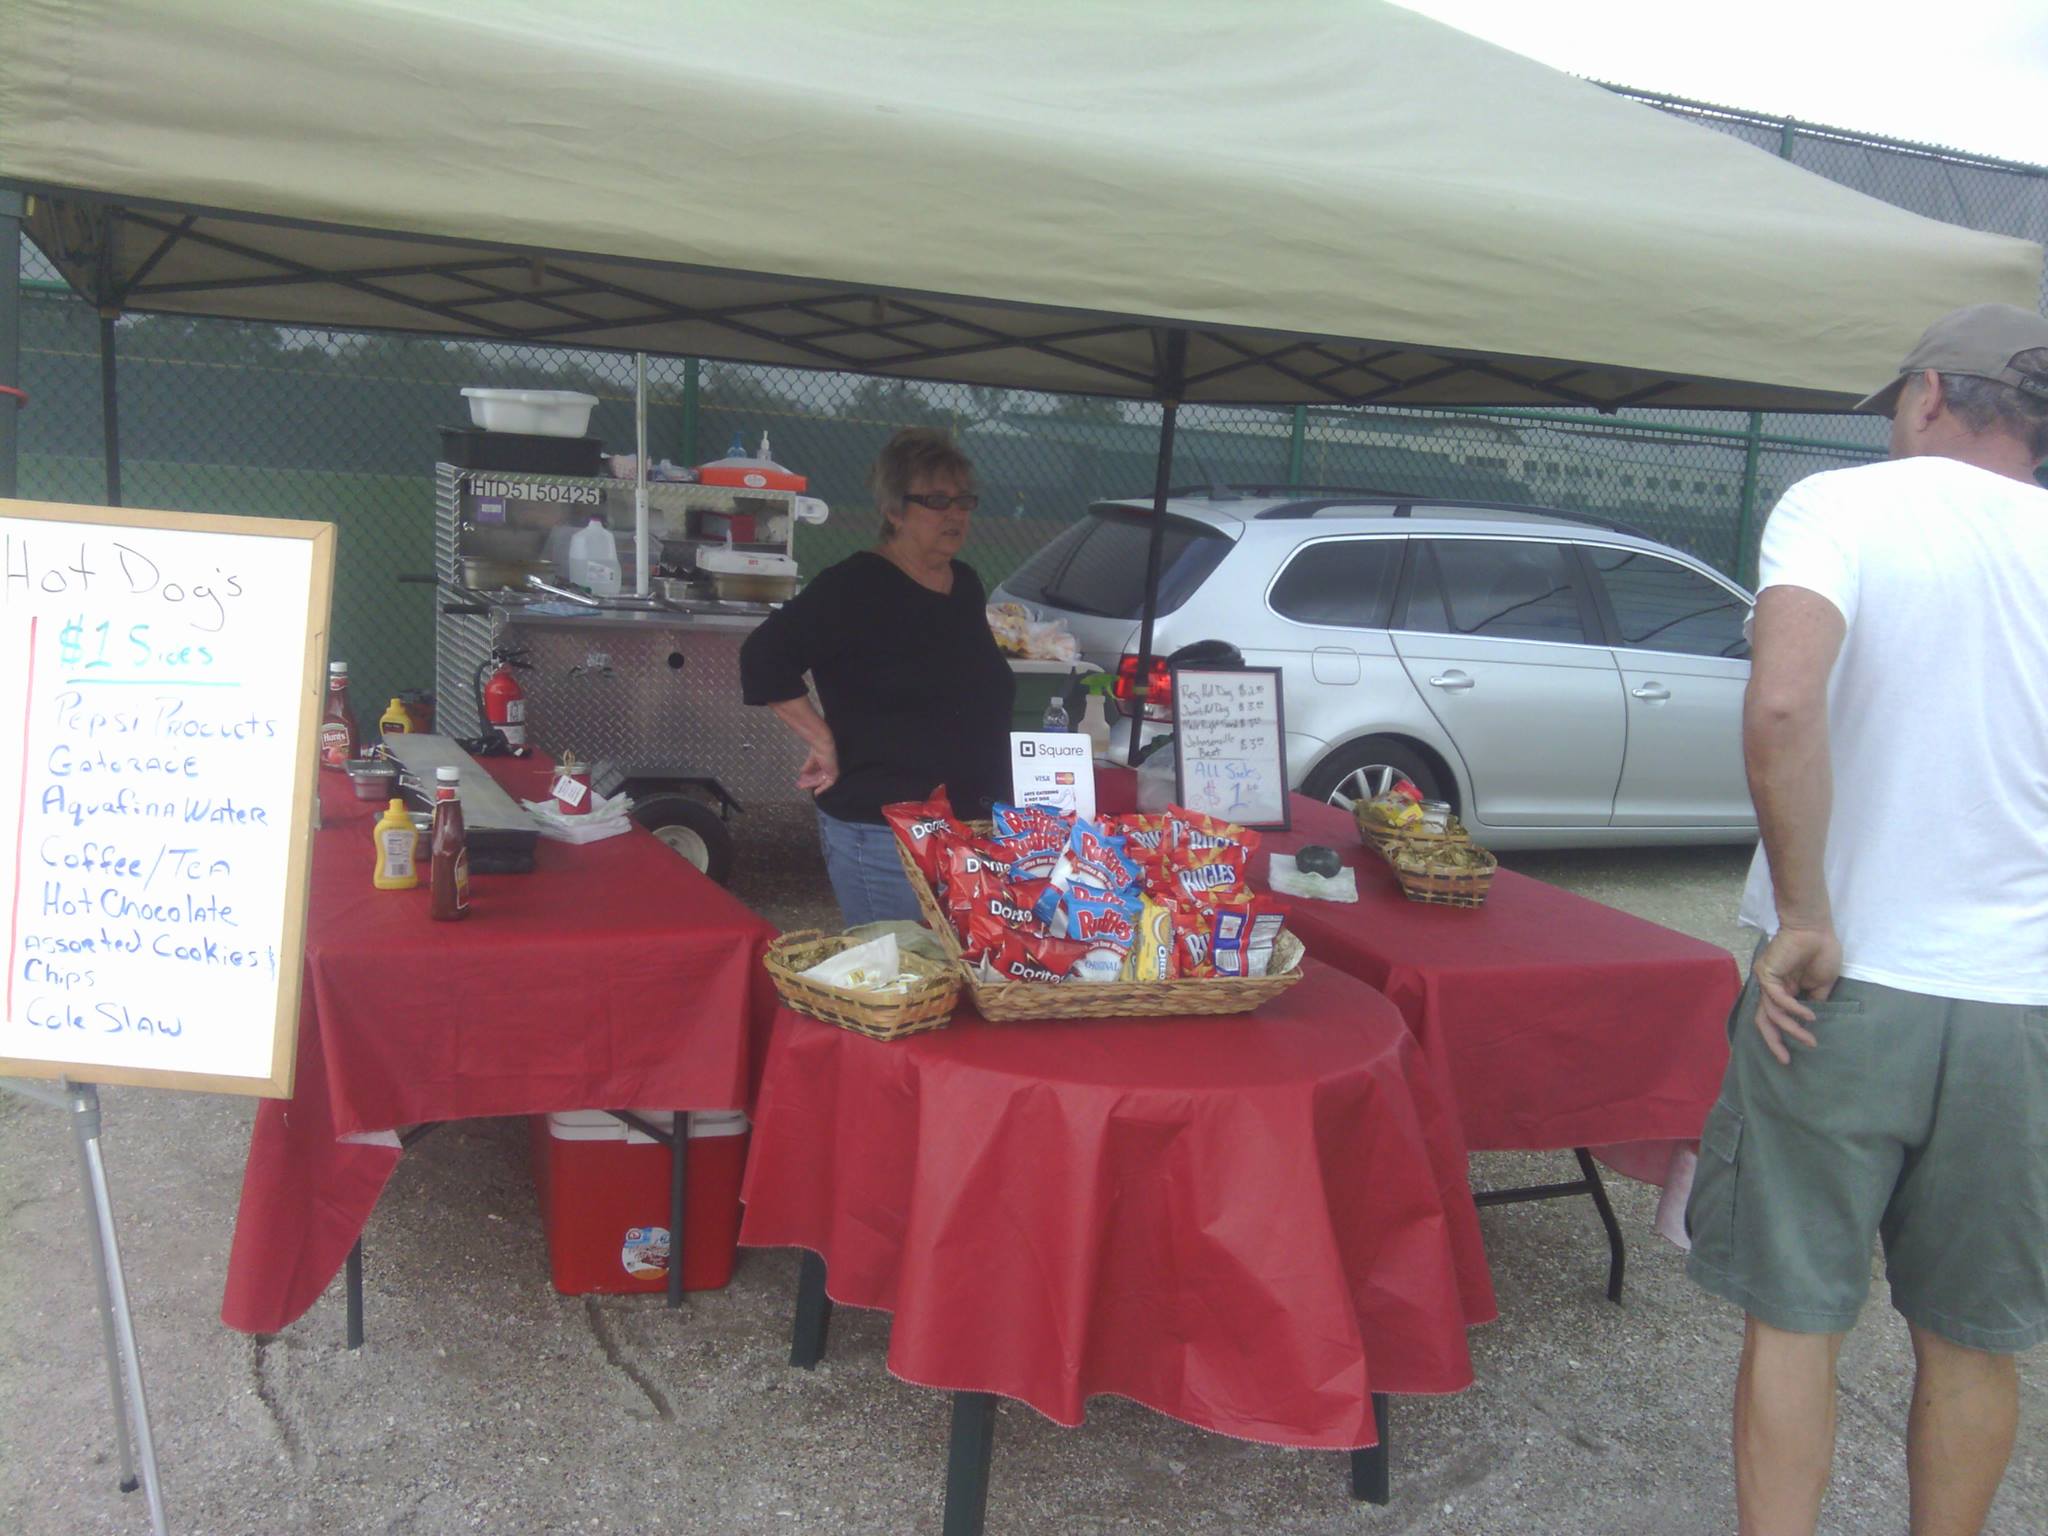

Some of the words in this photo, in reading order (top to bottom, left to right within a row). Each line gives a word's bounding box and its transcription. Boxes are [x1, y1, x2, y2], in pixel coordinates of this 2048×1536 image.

[6, 534, 96, 600] Hot
[113, 543, 242, 632] Dog's
[59, 614, 112, 669] $1
[55, 690, 138, 738] Pepsi
[1038, 743, 1084, 757] Square
[42, 784, 175, 827] Aquafina
[1082, 832, 1133, 888] Ruffles
[44, 881, 93, 916] Hot
[100, 888, 238, 926] Chocolate
[1077, 908, 1133, 941] Ruffles
[24, 958, 96, 991] Chips
